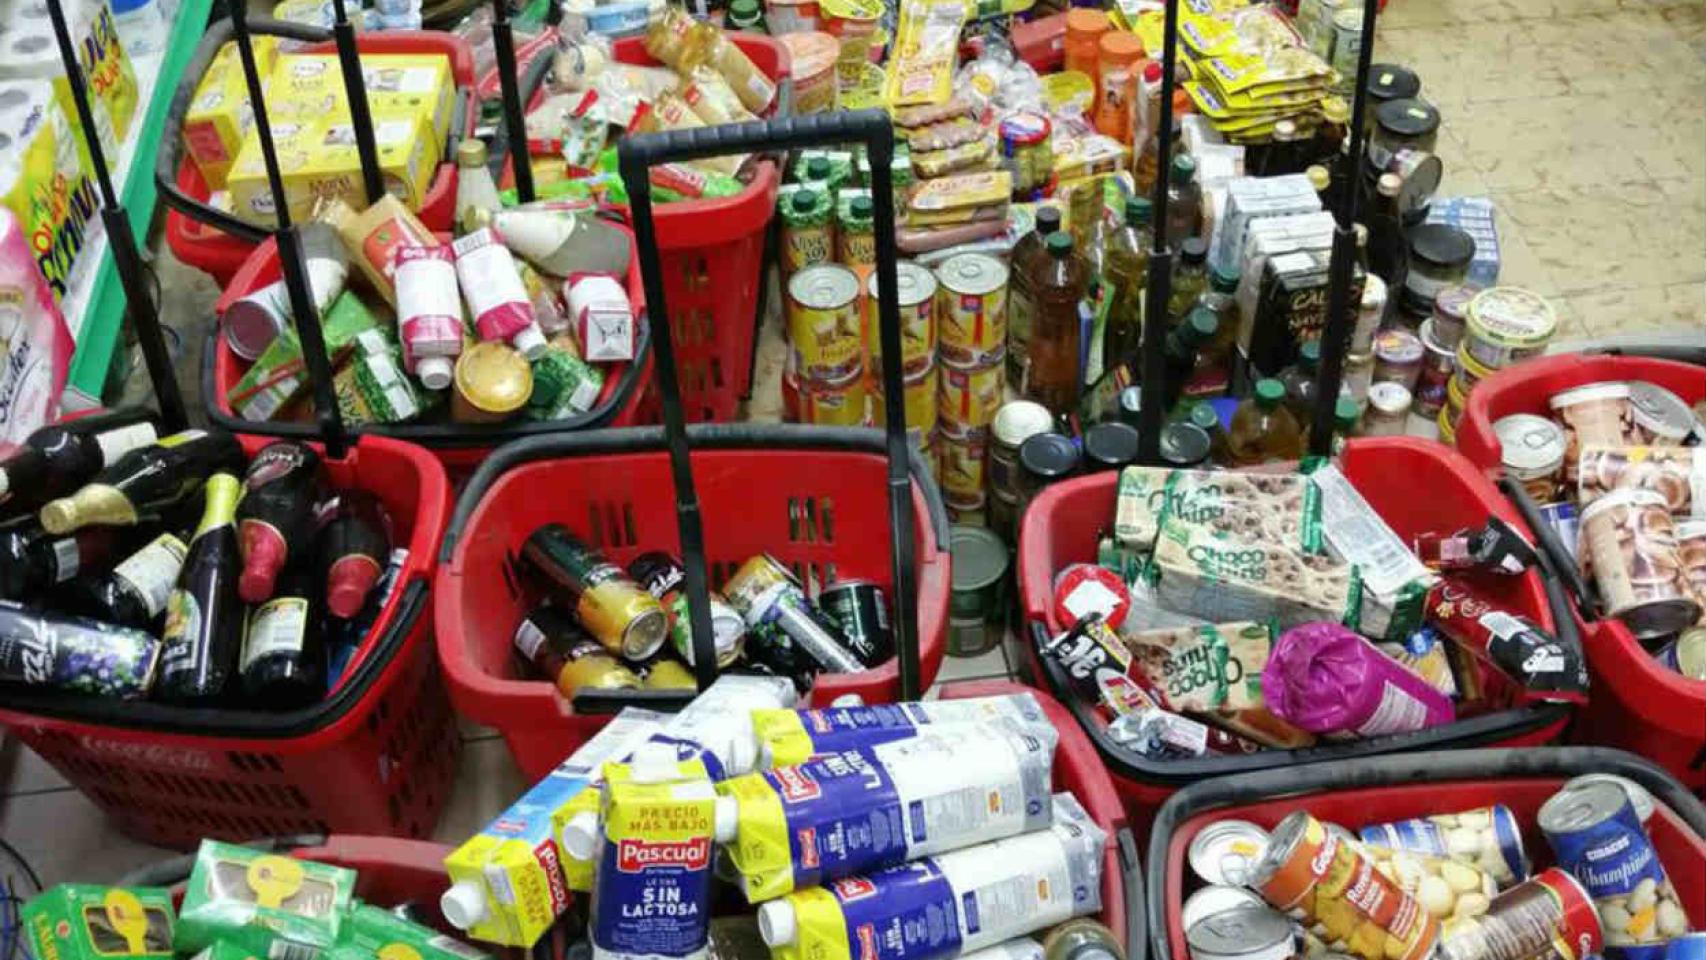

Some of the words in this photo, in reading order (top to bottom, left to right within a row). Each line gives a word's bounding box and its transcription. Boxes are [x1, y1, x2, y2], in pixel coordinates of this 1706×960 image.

[638, 805, 699, 819] PRECIO
[669, 816, 708, 831] BAJO
[623, 840, 706, 862] Pascual
[642, 886, 682, 904] SIN
[621, 902, 699, 918] LACTOSA
